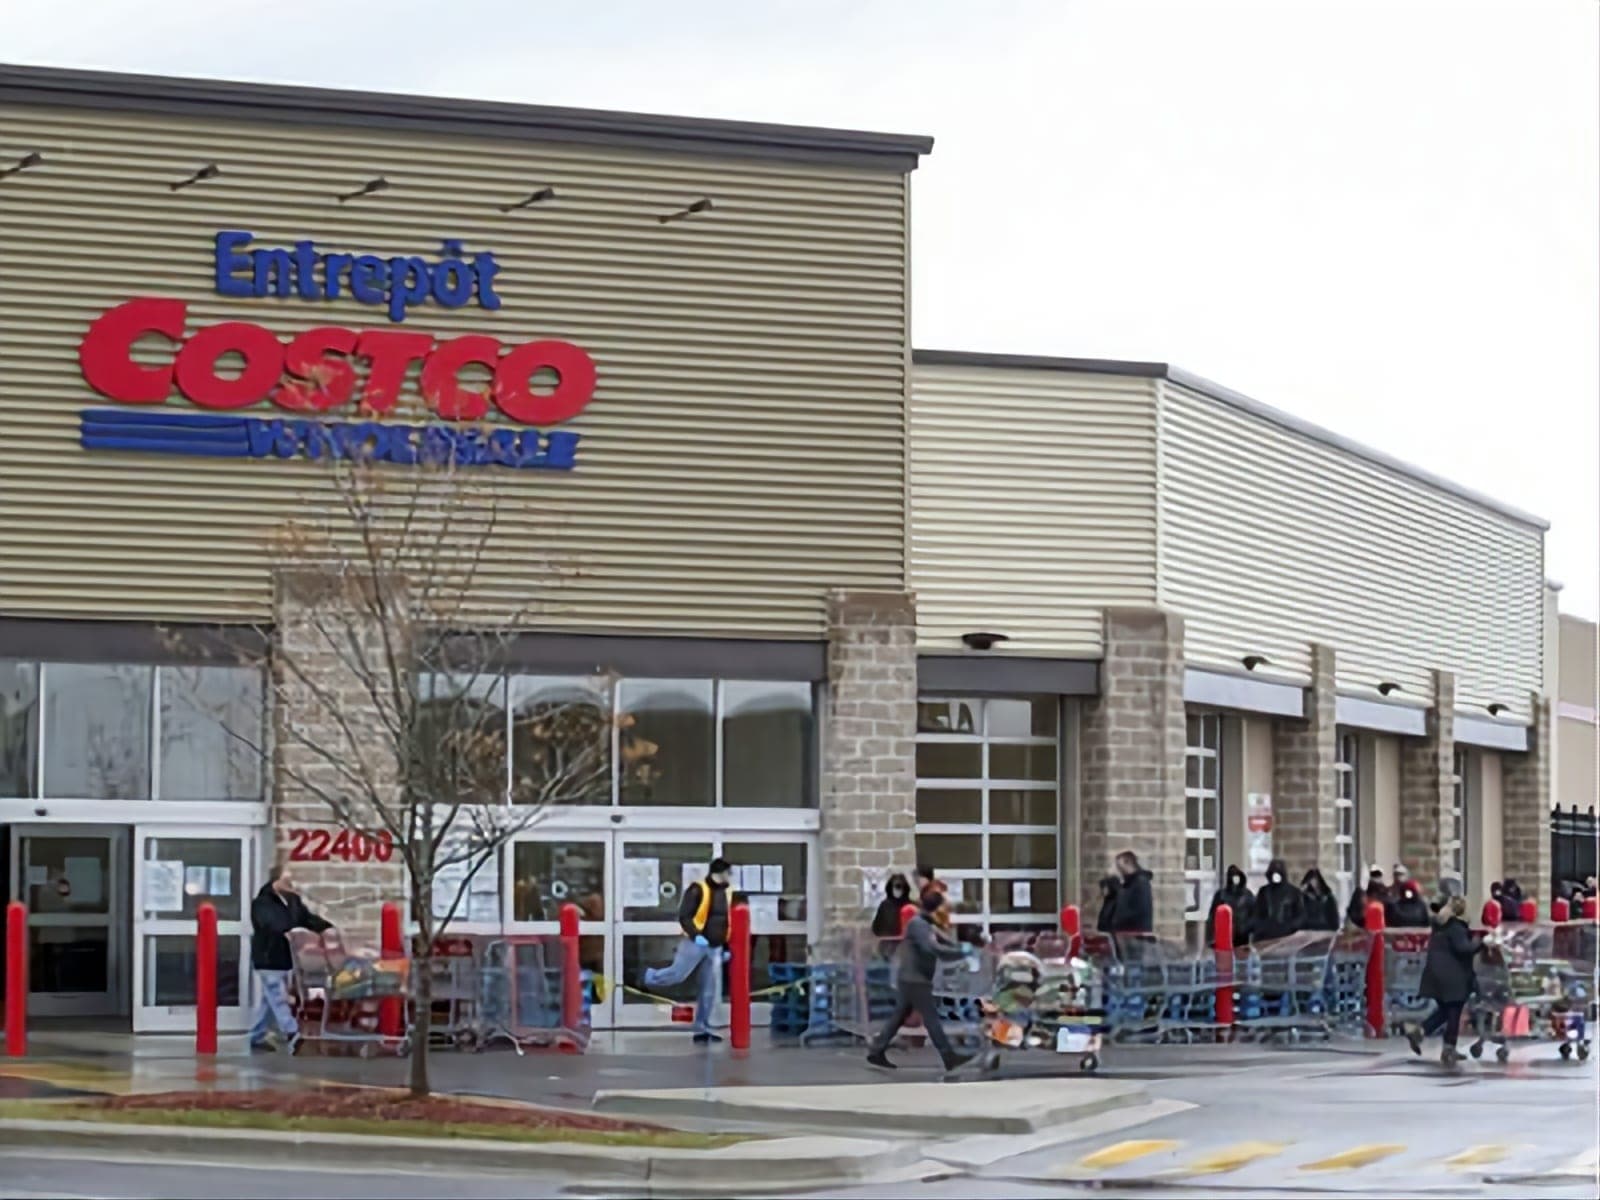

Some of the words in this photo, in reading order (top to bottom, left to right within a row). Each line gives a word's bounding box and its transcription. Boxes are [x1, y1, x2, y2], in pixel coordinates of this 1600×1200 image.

[214, 229, 502, 322] Entrepôt
[79, 297, 597, 425] COSTCO
[290, 829, 392, 862] 22400
